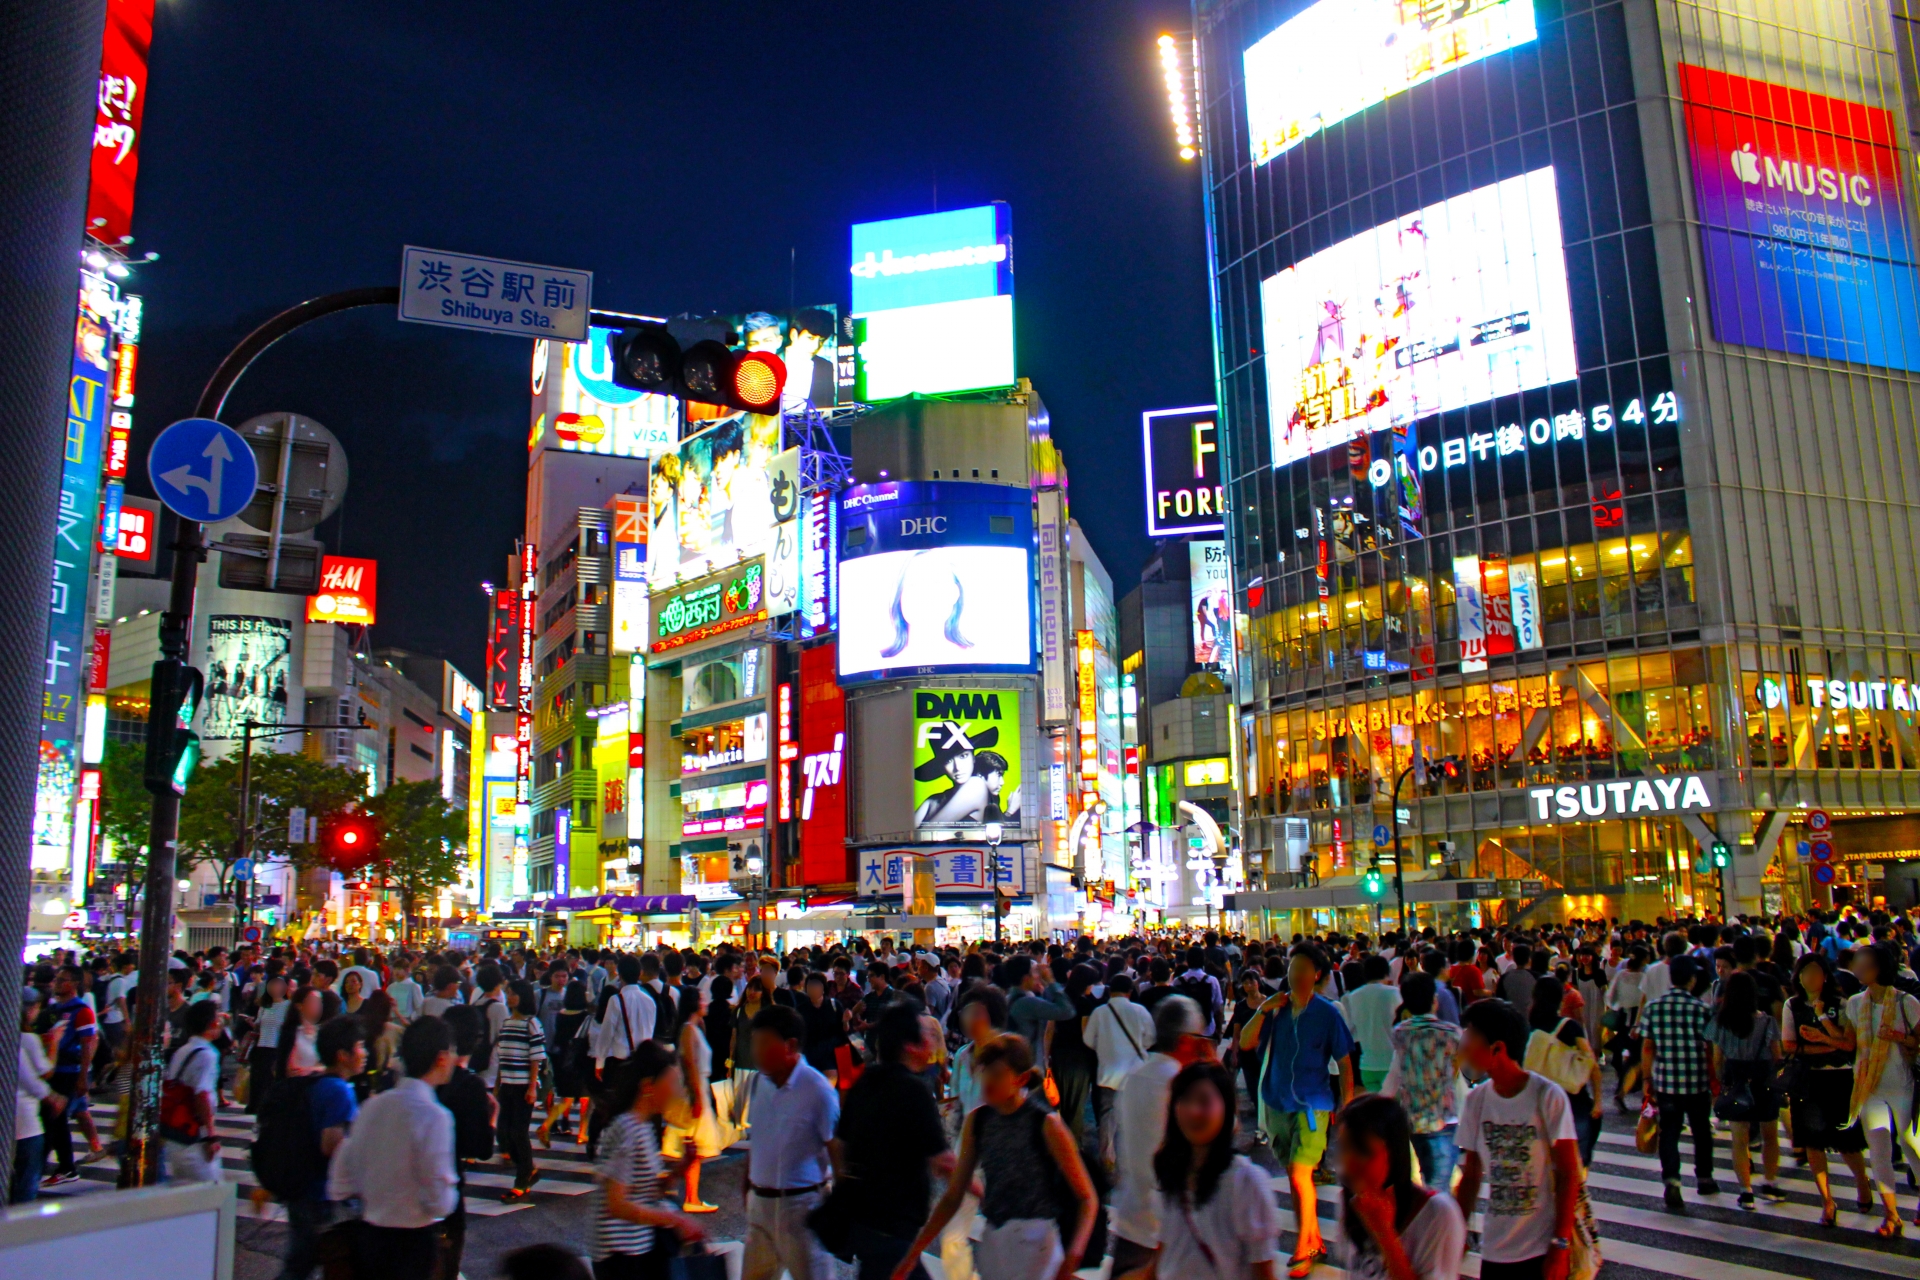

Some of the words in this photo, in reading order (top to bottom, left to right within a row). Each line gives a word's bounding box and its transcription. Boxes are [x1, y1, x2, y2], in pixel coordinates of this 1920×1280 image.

[1764, 156, 1871, 207] MUSIC
[418, 259, 576, 311] 渋谷駅前
[441, 299, 513, 325] Shibuya
[520, 309, 555, 329] Sta.
[554, 421, 606, 434] MasterCard
[633, 428, 669, 443] VISA
[843, 498, 862, 510] DHC
[862, 489, 899, 505] Channel
[900, 516, 947, 537] DHC
[1041, 517, 1060, 591] Taisei
[322, 564, 364, 592] H&M
[211, 619, 238, 631] THIS
[685, 594, 721, 628] 西村
[1044, 599, 1058, 662] neon
[917, 666, 935, 674] DHC
[916, 693, 1002, 720] DMM
[1313, 701, 1447, 741] STARBUCKS
[1466, 685, 1563, 718] COFFEE
[917, 722, 974, 750] FX
[684, 747, 743, 772] Euphoria
[1530, 776, 1711, 820] TSUTAYA
[866, 854, 1014, 887] 大盛書店
[1844, 851, 1894, 862] STARBUCKS
